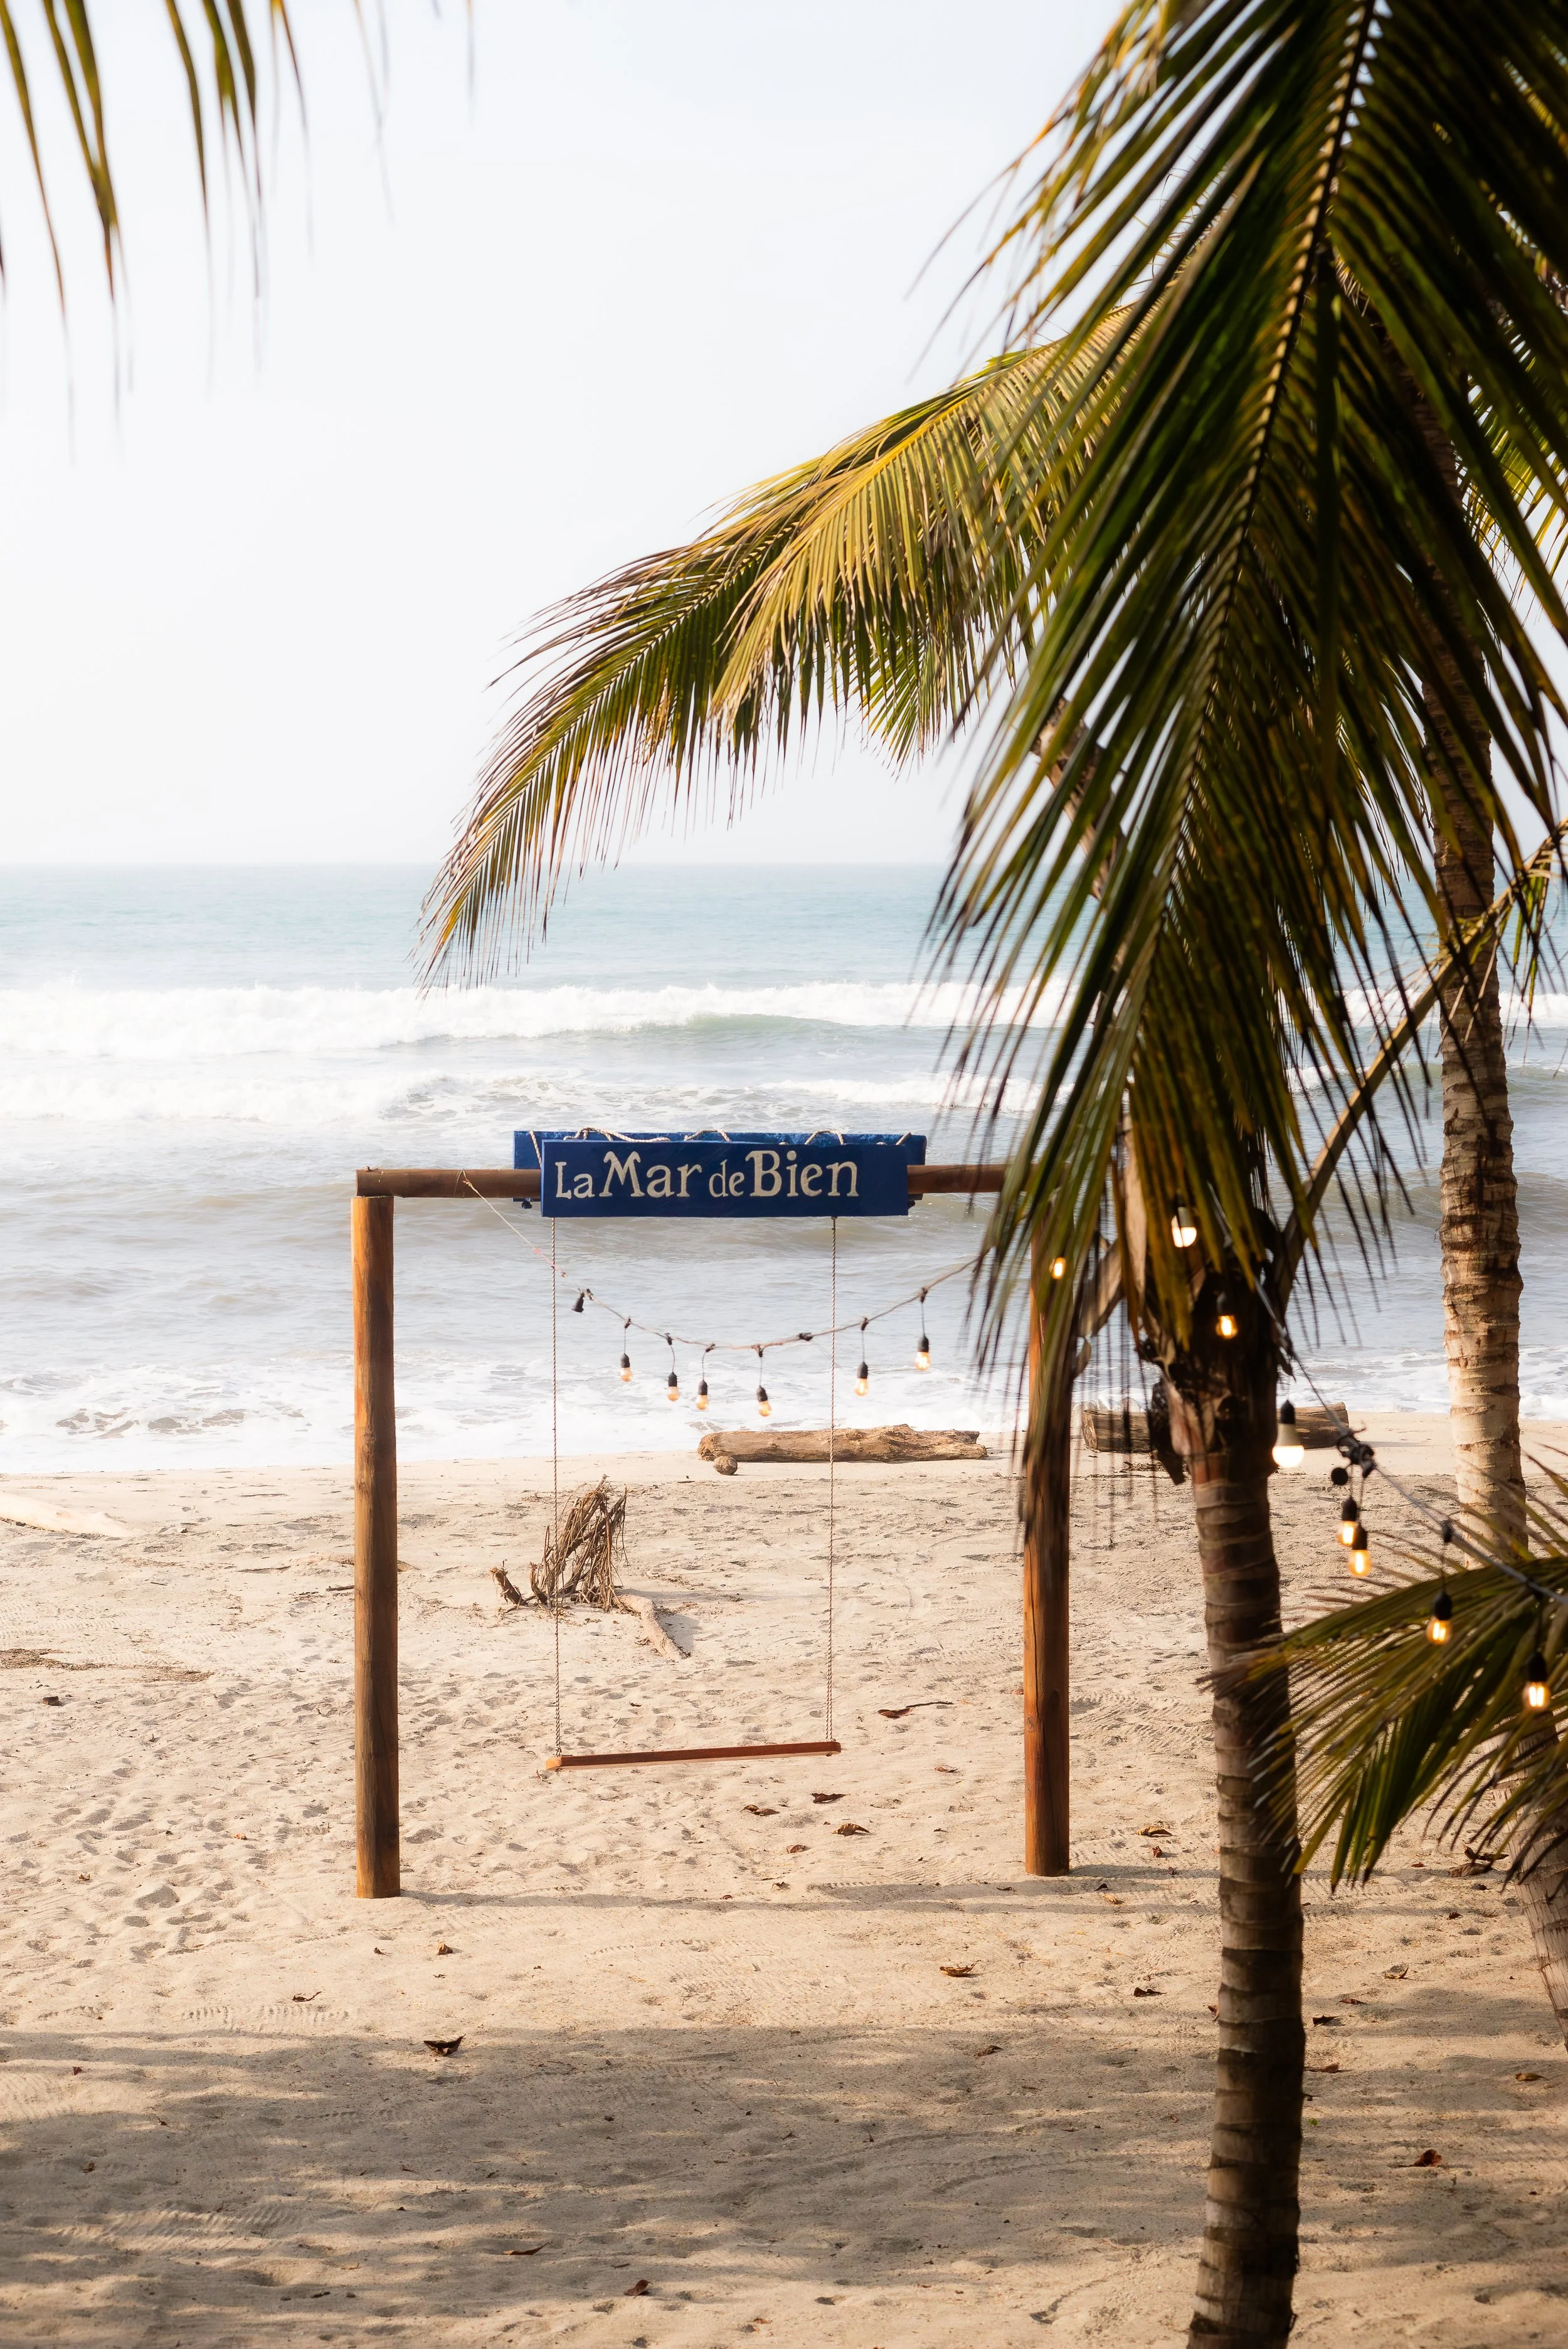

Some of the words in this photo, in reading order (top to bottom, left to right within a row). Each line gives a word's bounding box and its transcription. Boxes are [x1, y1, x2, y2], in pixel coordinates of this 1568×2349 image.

[555, 1161, 595, 1199] La
[599, 1150, 702, 1197] Mar
[709, 1159, 744, 1197] de
[745, 1150, 859, 1197] Bien
